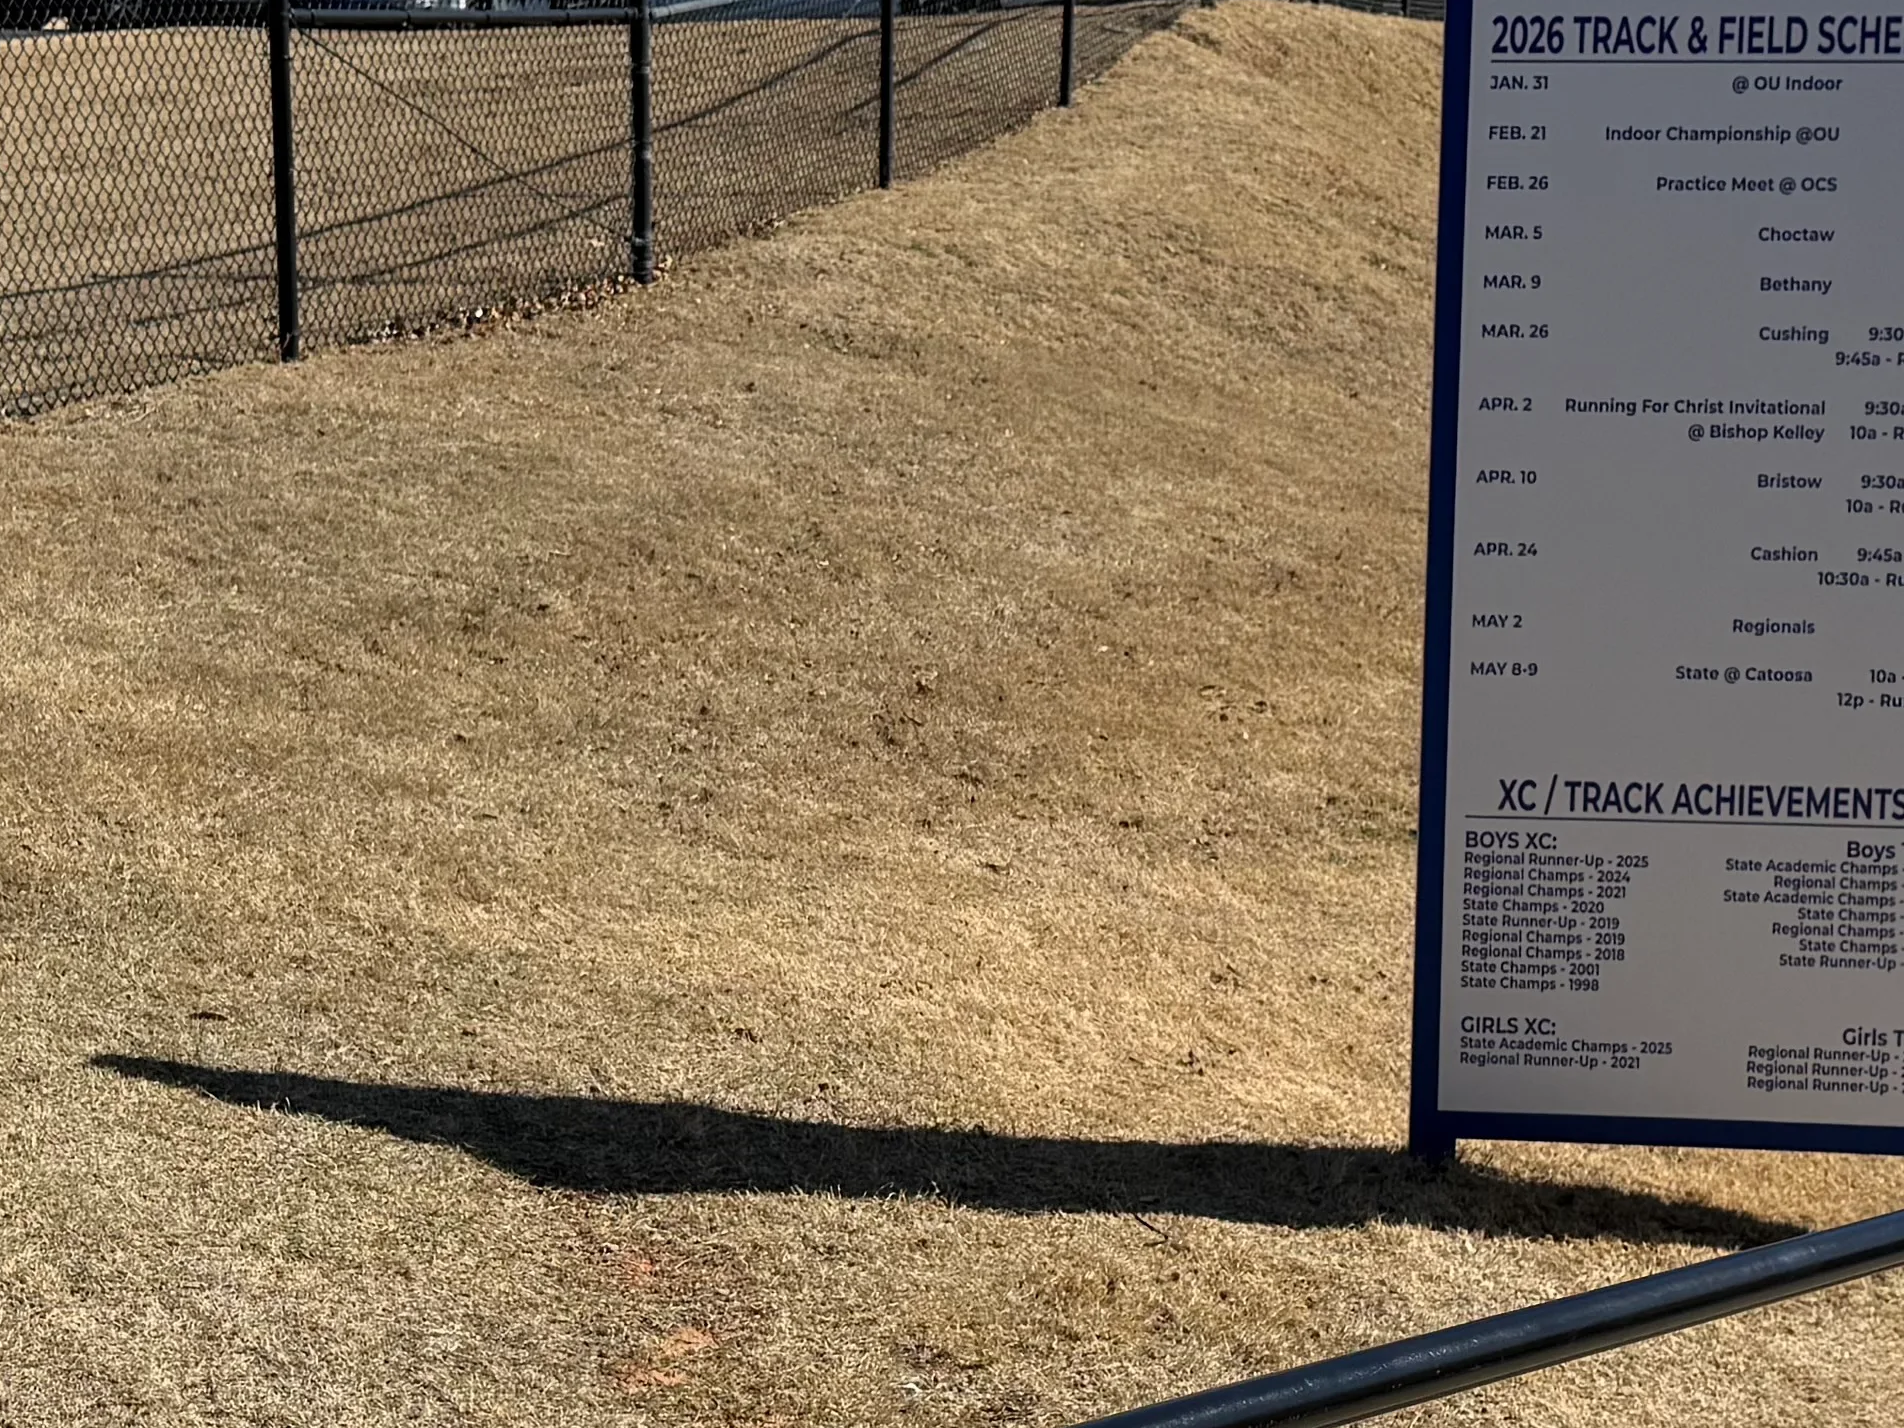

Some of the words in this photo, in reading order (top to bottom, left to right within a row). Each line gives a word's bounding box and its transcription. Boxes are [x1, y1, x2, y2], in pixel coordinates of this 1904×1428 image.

[1491, 15, 1565, 55] 2026
[1573, 15, 1680, 55] TRACK
[1687, 16, 1708, 55] &
[1718, 15, 1809, 55] FIELD
[1489, 75, 1529, 91] JAN.
[1532, 75, 1549, 91] 31
[1732, 75, 1750, 95] @
[1754, 76, 1781, 91] OU
[1785, 75, 1843, 91] Indoor
[1488, 125, 1526, 141] FEB.
[1530, 125, 1547, 141] 21
[1605, 125, 1662, 141] Indoor
[1666, 125, 1792, 145] Championship
[1795, 127, 1840, 146] @OU
[1486, 175, 1525, 191] FEB.
[1528, 175, 1549, 191] 26
[1656, 175, 1727, 192] Practice
[1731, 177, 1775, 192] Meet
[1779, 177, 1797, 196] @
[1801, 177, 1838, 192] OCS
[1485, 225, 1529, 240] MAR.
[1533, 225, 1543, 240] 5
[1758, 227, 1835, 242] Choctaw
[1483, 274, 1527, 290] MAR.
[1530, 274, 1542, 290] 9
[1760, 276, 1833, 296] Bethany
[1479, 397, 1519, 412] APR.
[1523, 397, 1532, 412] 2
[1565, 397, 1637, 417] Running
[1642, 399, 1670, 414] For
[1674, 398, 1724, 415] Christ
[1729, 398, 1826, 416] Invitational
[1472, 614, 1509, 629] MAY
[1513, 614, 1523, 629] 2
[1732, 618, 1816, 637] Regionals
[1498, 779, 1538, 812] XC
[1543, 774, 1559, 816] /
[1564, 780, 1665, 815] TRACK
[1465, 830, 1520, 850] BOYS
[1525, 832, 1557, 851] XC:
[1847, 840, 1896, 863] Boys
[1463, 866, 1525, 883] Regional
[1527, 868, 1585, 885] Champs
[1597, 869, 1631, 884] 2024
[1460, 1015, 1519, 1035] GIRLS
[1524, 1017, 1557, 1036] XC:
[1842, 1026, 1888, 1047] Girls
